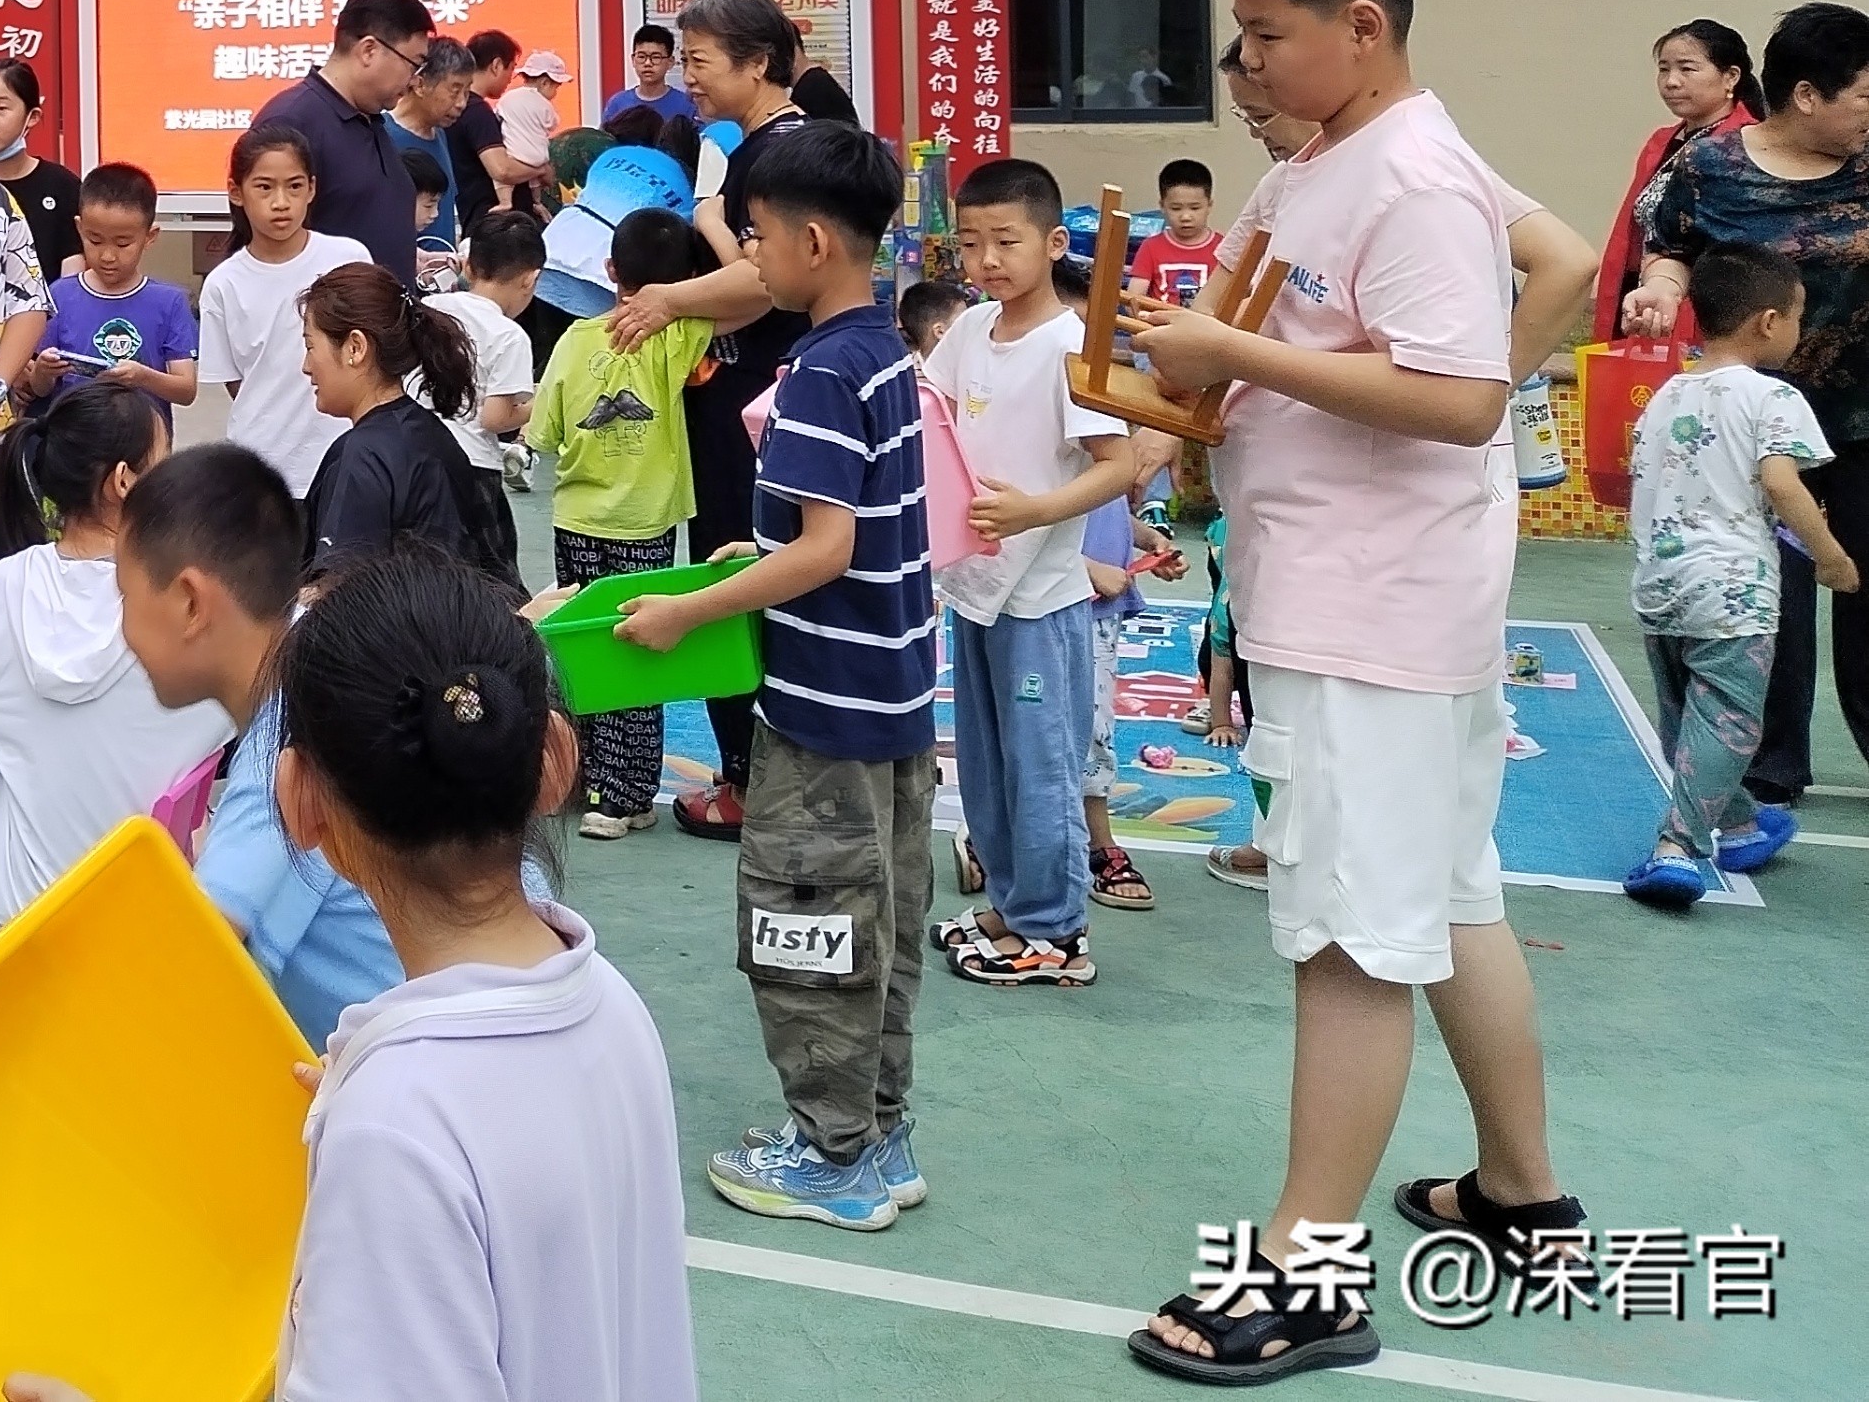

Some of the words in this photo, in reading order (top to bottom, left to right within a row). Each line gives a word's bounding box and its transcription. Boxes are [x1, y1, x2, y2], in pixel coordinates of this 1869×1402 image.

[164, 109, 252, 130] 紫光园社区
[756, 916, 847, 959] hsty
